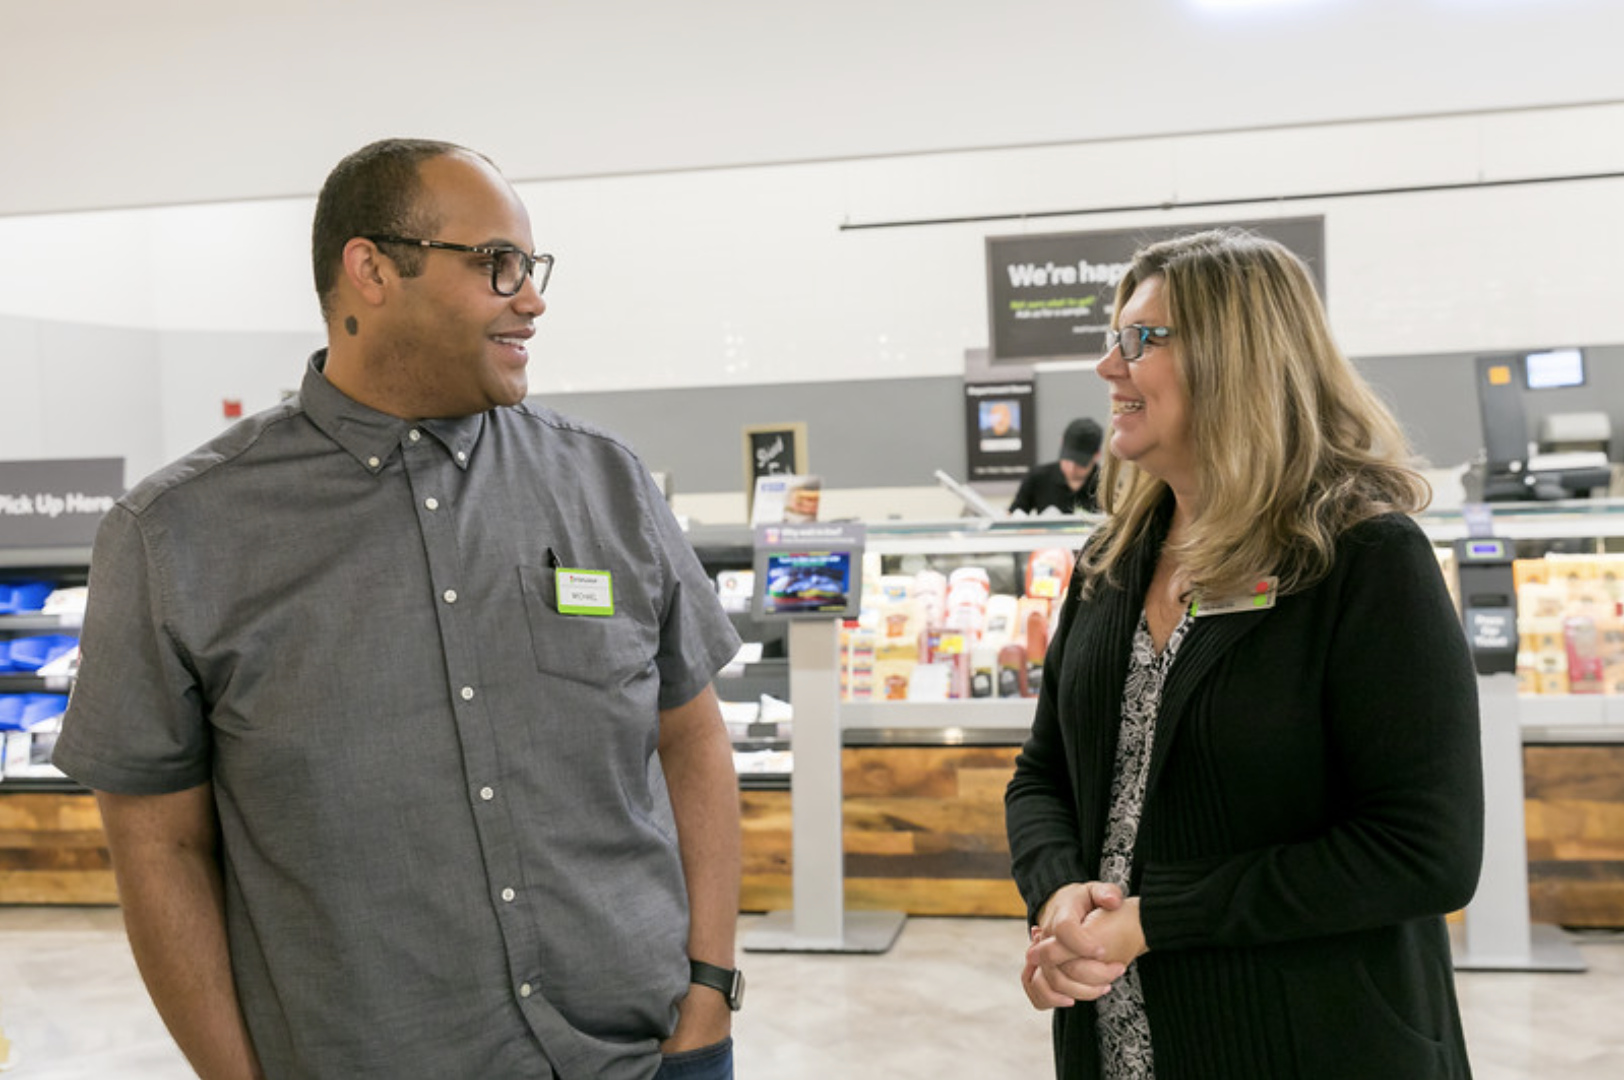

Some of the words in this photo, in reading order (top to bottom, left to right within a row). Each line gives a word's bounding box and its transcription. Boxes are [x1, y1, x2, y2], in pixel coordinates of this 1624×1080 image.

[1007, 261, 1077, 287] We're
[1078, 259, 1131, 287] hap
[35, 492, 64, 518] Up
[65, 492, 114, 513] Here
